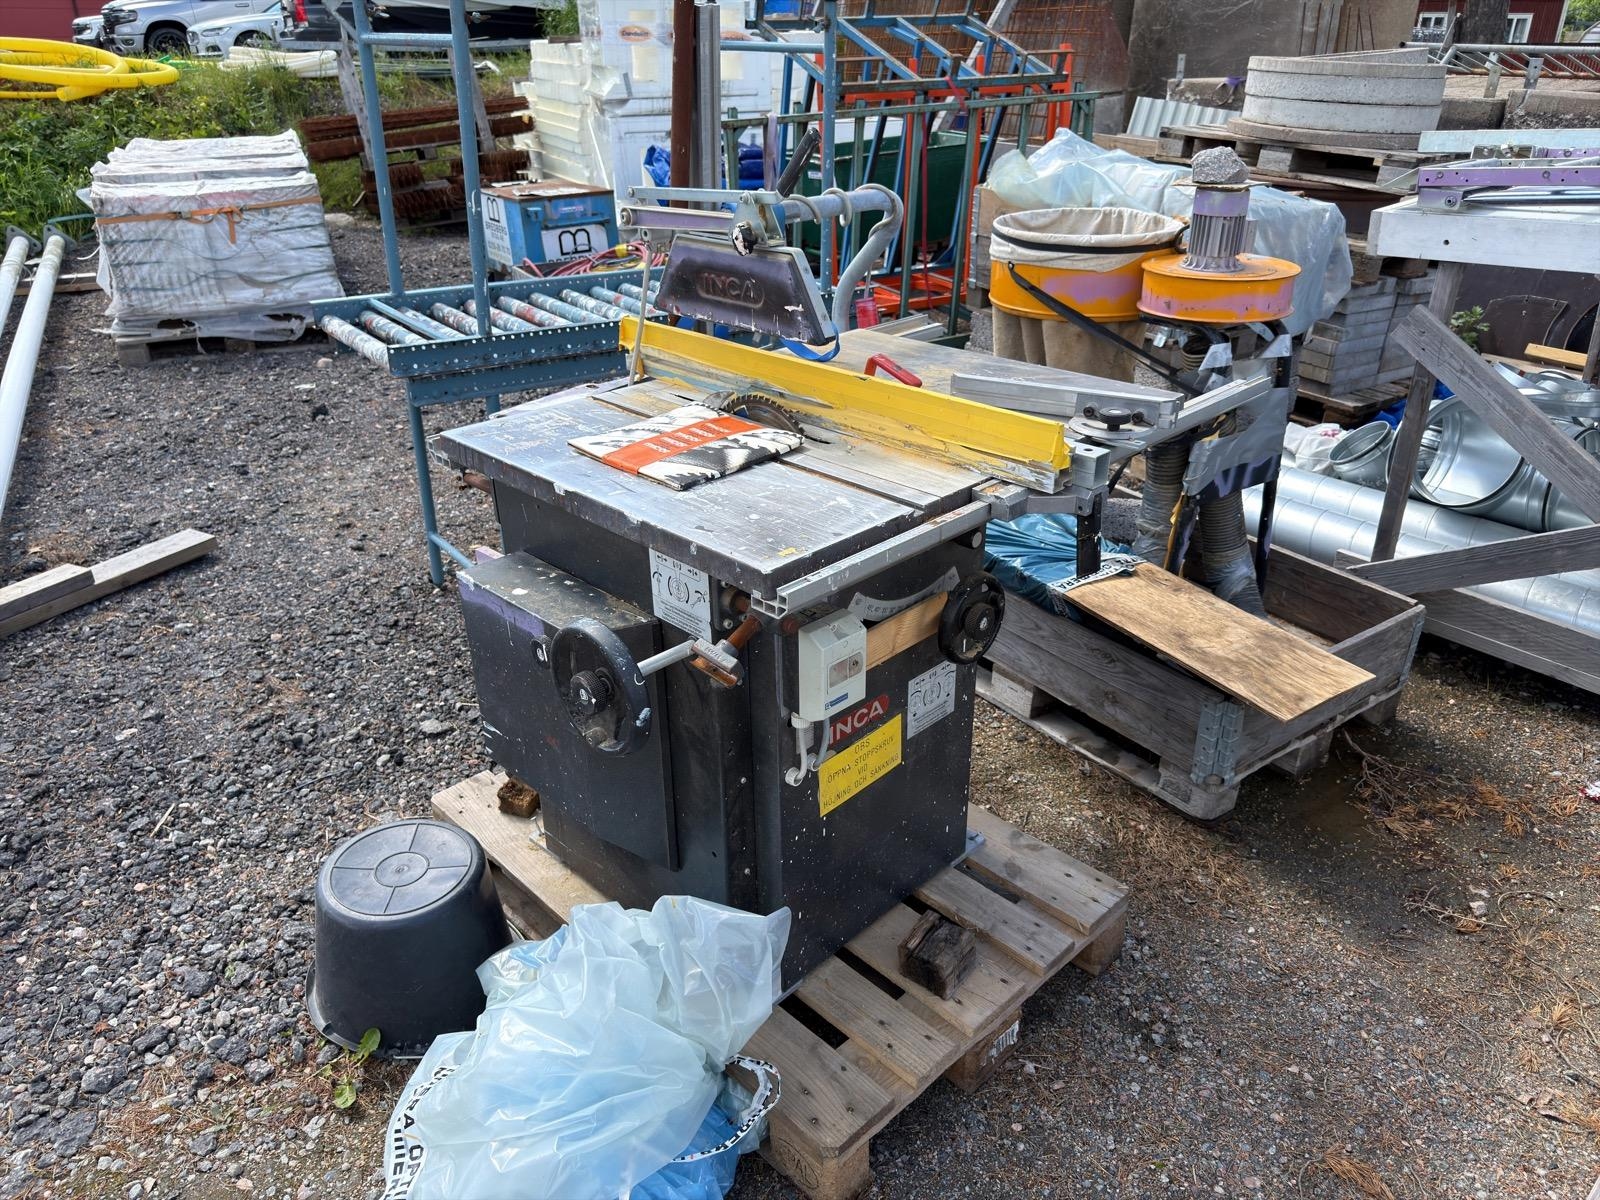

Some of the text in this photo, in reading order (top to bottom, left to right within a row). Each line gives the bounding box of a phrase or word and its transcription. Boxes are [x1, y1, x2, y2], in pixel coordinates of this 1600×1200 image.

[702, 272, 759, 301] INCA
[829, 700, 884, 745] INCA
[854, 738, 870, 754] OBS
[857, 763, 868, 776] VID
[854, 775, 867, 789] OCH
